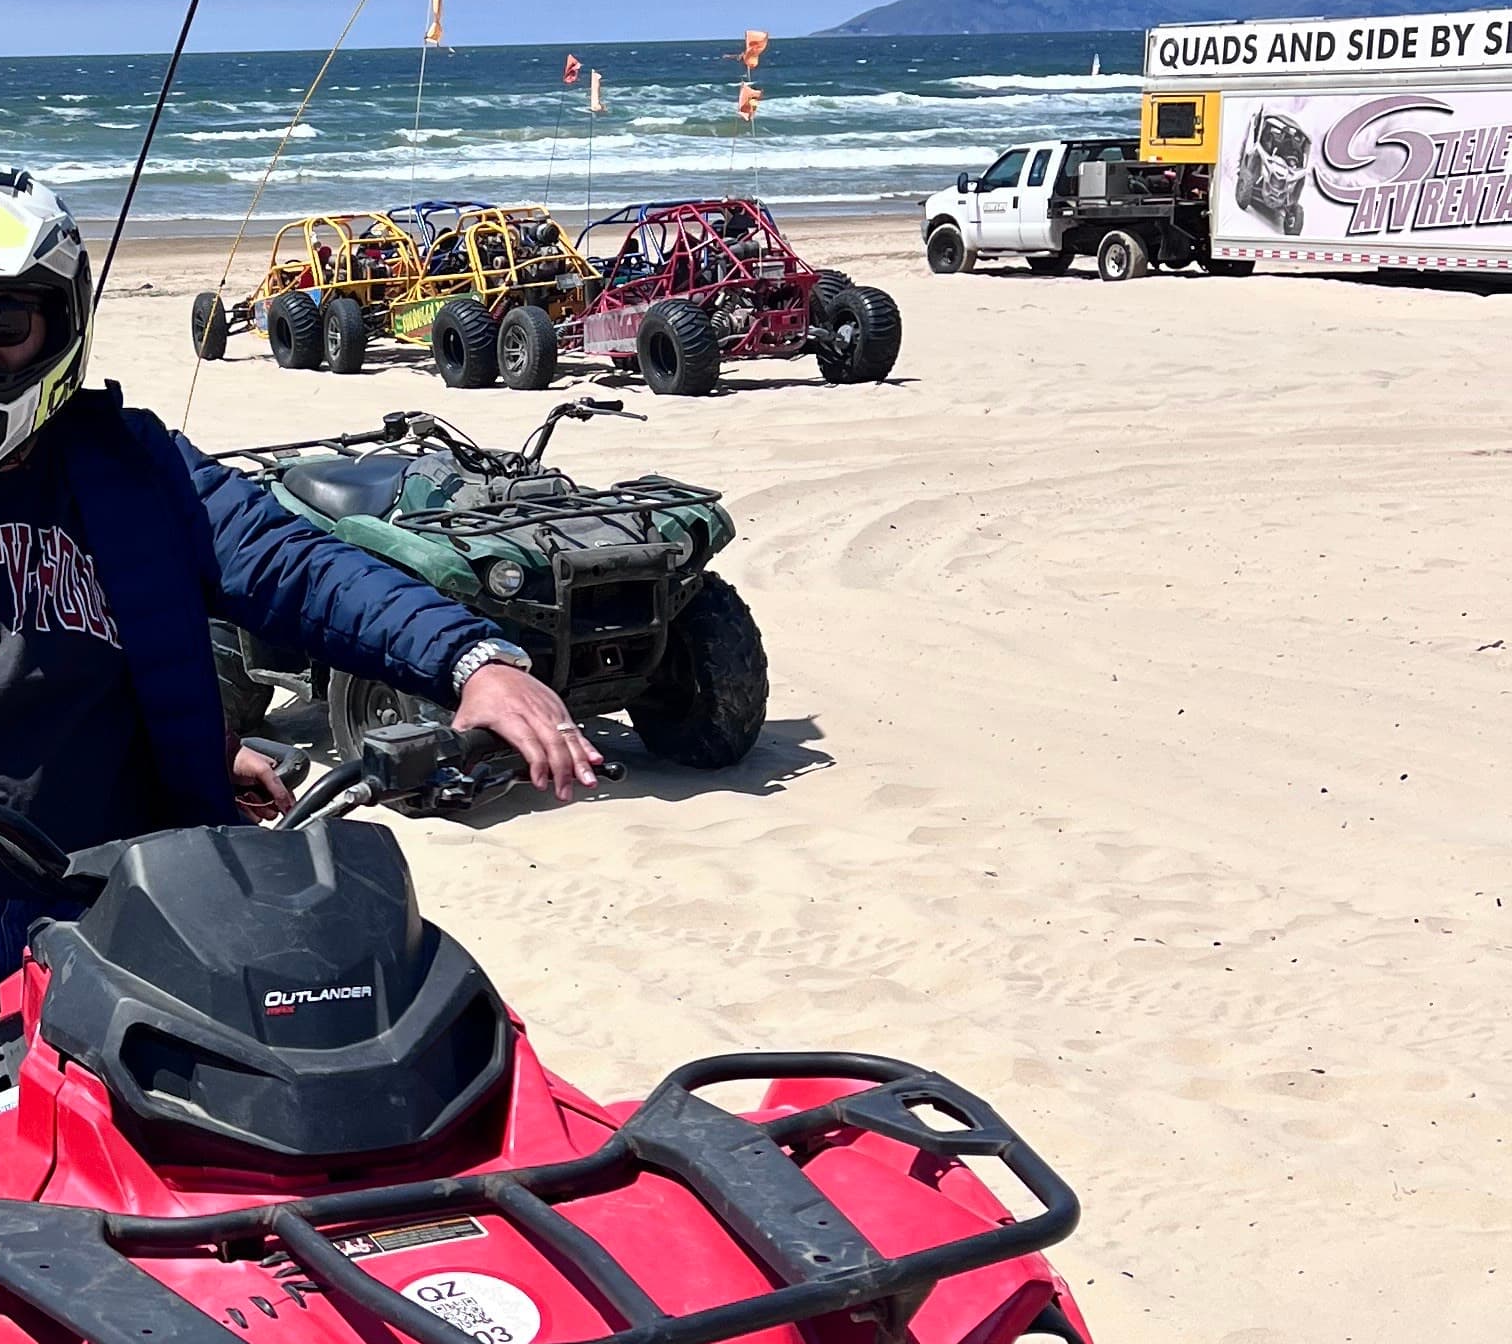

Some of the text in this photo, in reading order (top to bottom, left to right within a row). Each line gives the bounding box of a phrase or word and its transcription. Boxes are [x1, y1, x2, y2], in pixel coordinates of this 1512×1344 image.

[1159, 33, 1258, 70] QUADS
[1267, 31, 1336, 64] AND
[1347, 26, 1419, 61] SIDE
[1430, 23, 1475, 57] BY
[1347, 182, 1419, 236] ATV
[264, 985, 372, 1007] OUTLANDER
[417, 1281, 466, 1303] QZ
